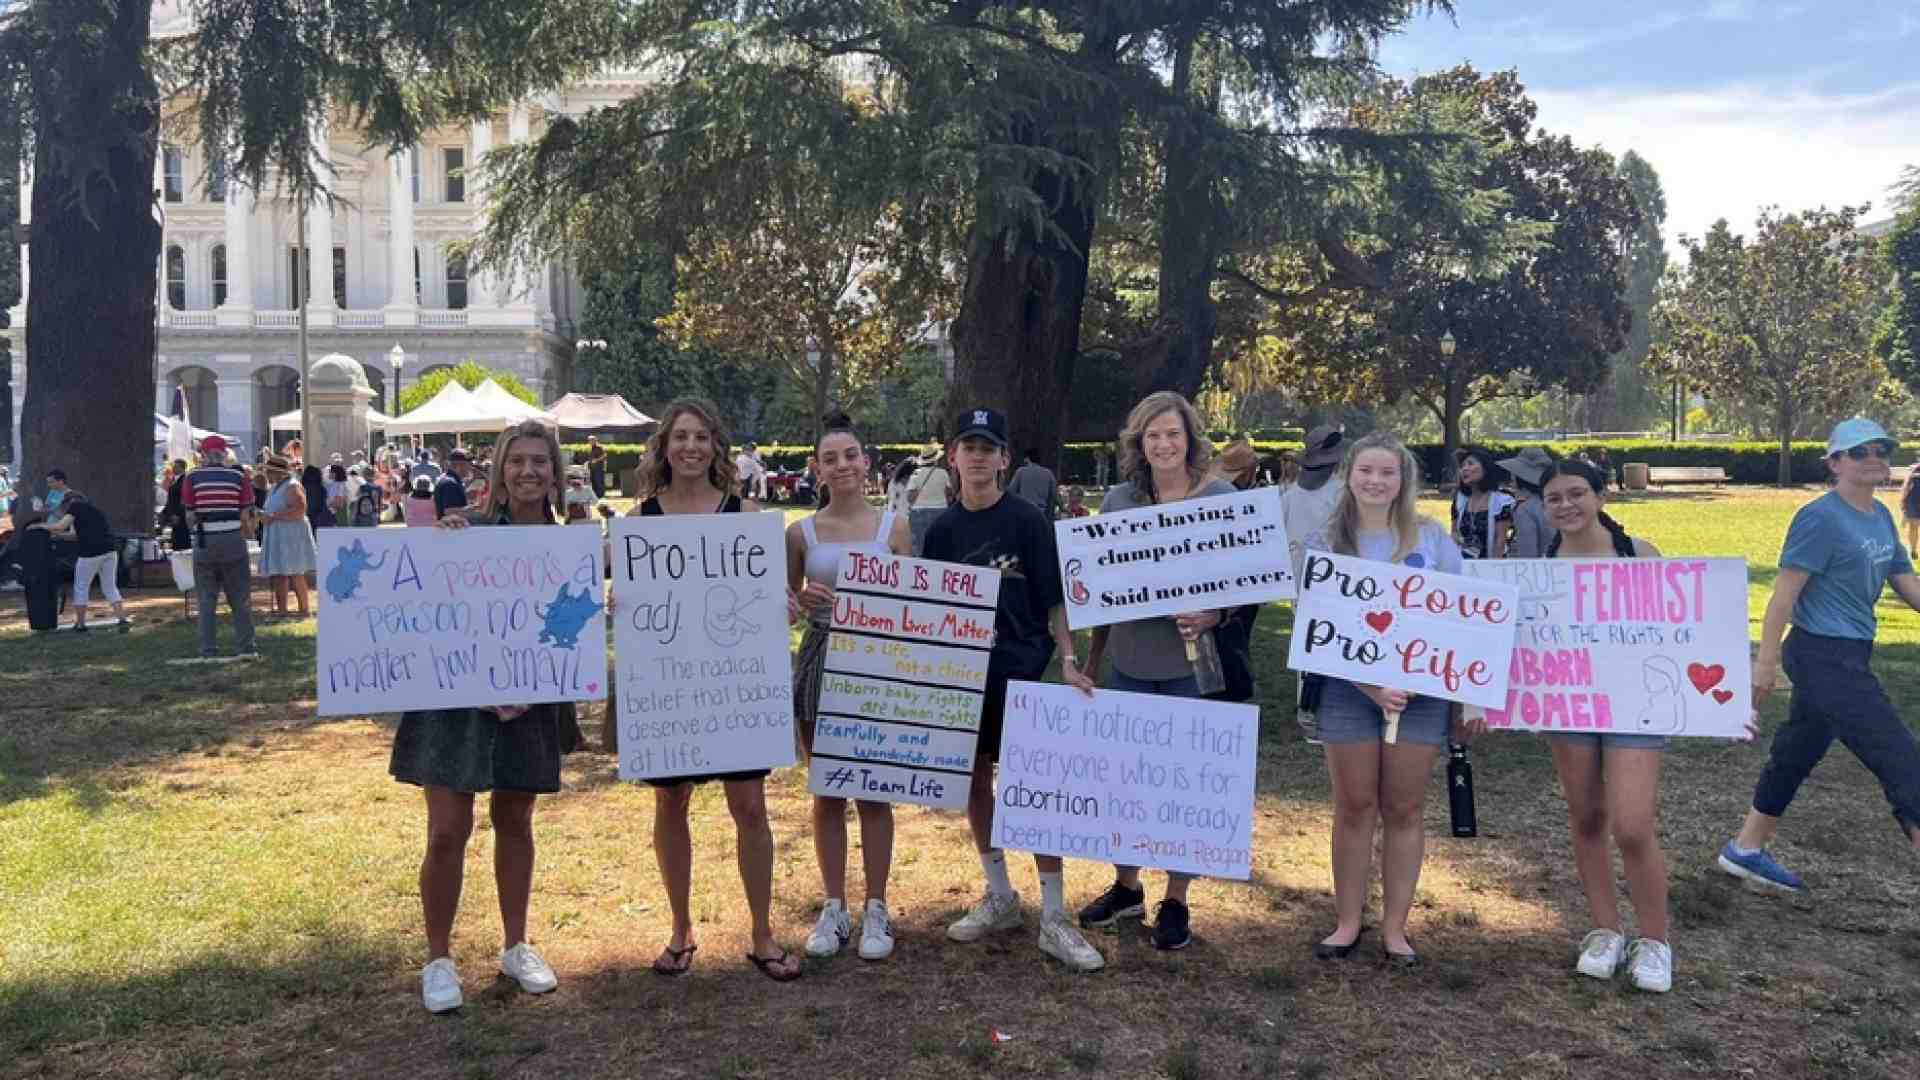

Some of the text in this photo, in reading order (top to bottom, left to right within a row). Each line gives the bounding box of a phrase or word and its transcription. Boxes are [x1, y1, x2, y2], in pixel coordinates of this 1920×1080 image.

[1158, 502, 1236, 530] having
[1242, 503, 1256, 516] a
[392, 543, 422, 590] A
[574, 553, 597, 586] a
[624, 534, 767, 581] Pro-Life
[1097, 523, 1276, 567] clump of cells!!"
[845, 552, 983, 598] JESUS IS REAL
[1100, 569, 1293, 609] Said no one ever.
[1491, 561, 1568, 594] TRUE
[1572, 561, 1708, 624] FEMINIST
[364, 598, 528, 642] person, no
[834, 596, 992, 640] Unborn Lives Matter
[1393, 574, 1510, 624] Love
[1530, 624, 1561, 646] FOR
[1568, 624, 1599, 644] THE
[1609, 624, 1664, 645] RIGHTS
[1673, 627, 1694, 645] OF
[329, 647, 416, 694] matter
[431, 644, 478, 689] how
[654, 656, 694, 681] The
[701, 655, 767, 677] radical
[896, 658, 918, 674] not
[938, 660, 985, 682] choice
[1395, 638, 1494, 694] Life
[626, 682, 790, 714] belief that babies
[823, 677, 973, 707] Unborn baby rights
[860, 701, 977, 726] are human rights
[628, 709, 790, 742] deserve a chance
[898, 733, 929, 746] and
[1082, 706, 1174, 747] noticed
[1186, 717, 1247, 757] that
[630, 742, 711, 774] at life.
[934, 754, 969, 768] made
[1006, 745, 1240, 795] everyone who is for
[1003, 779, 1241, 844] abortion has already
[1002, 816, 1051, 848] been
[1132, 836, 1187, 862] -Ronald
[1192, 839, 1250, 870] Reagan
